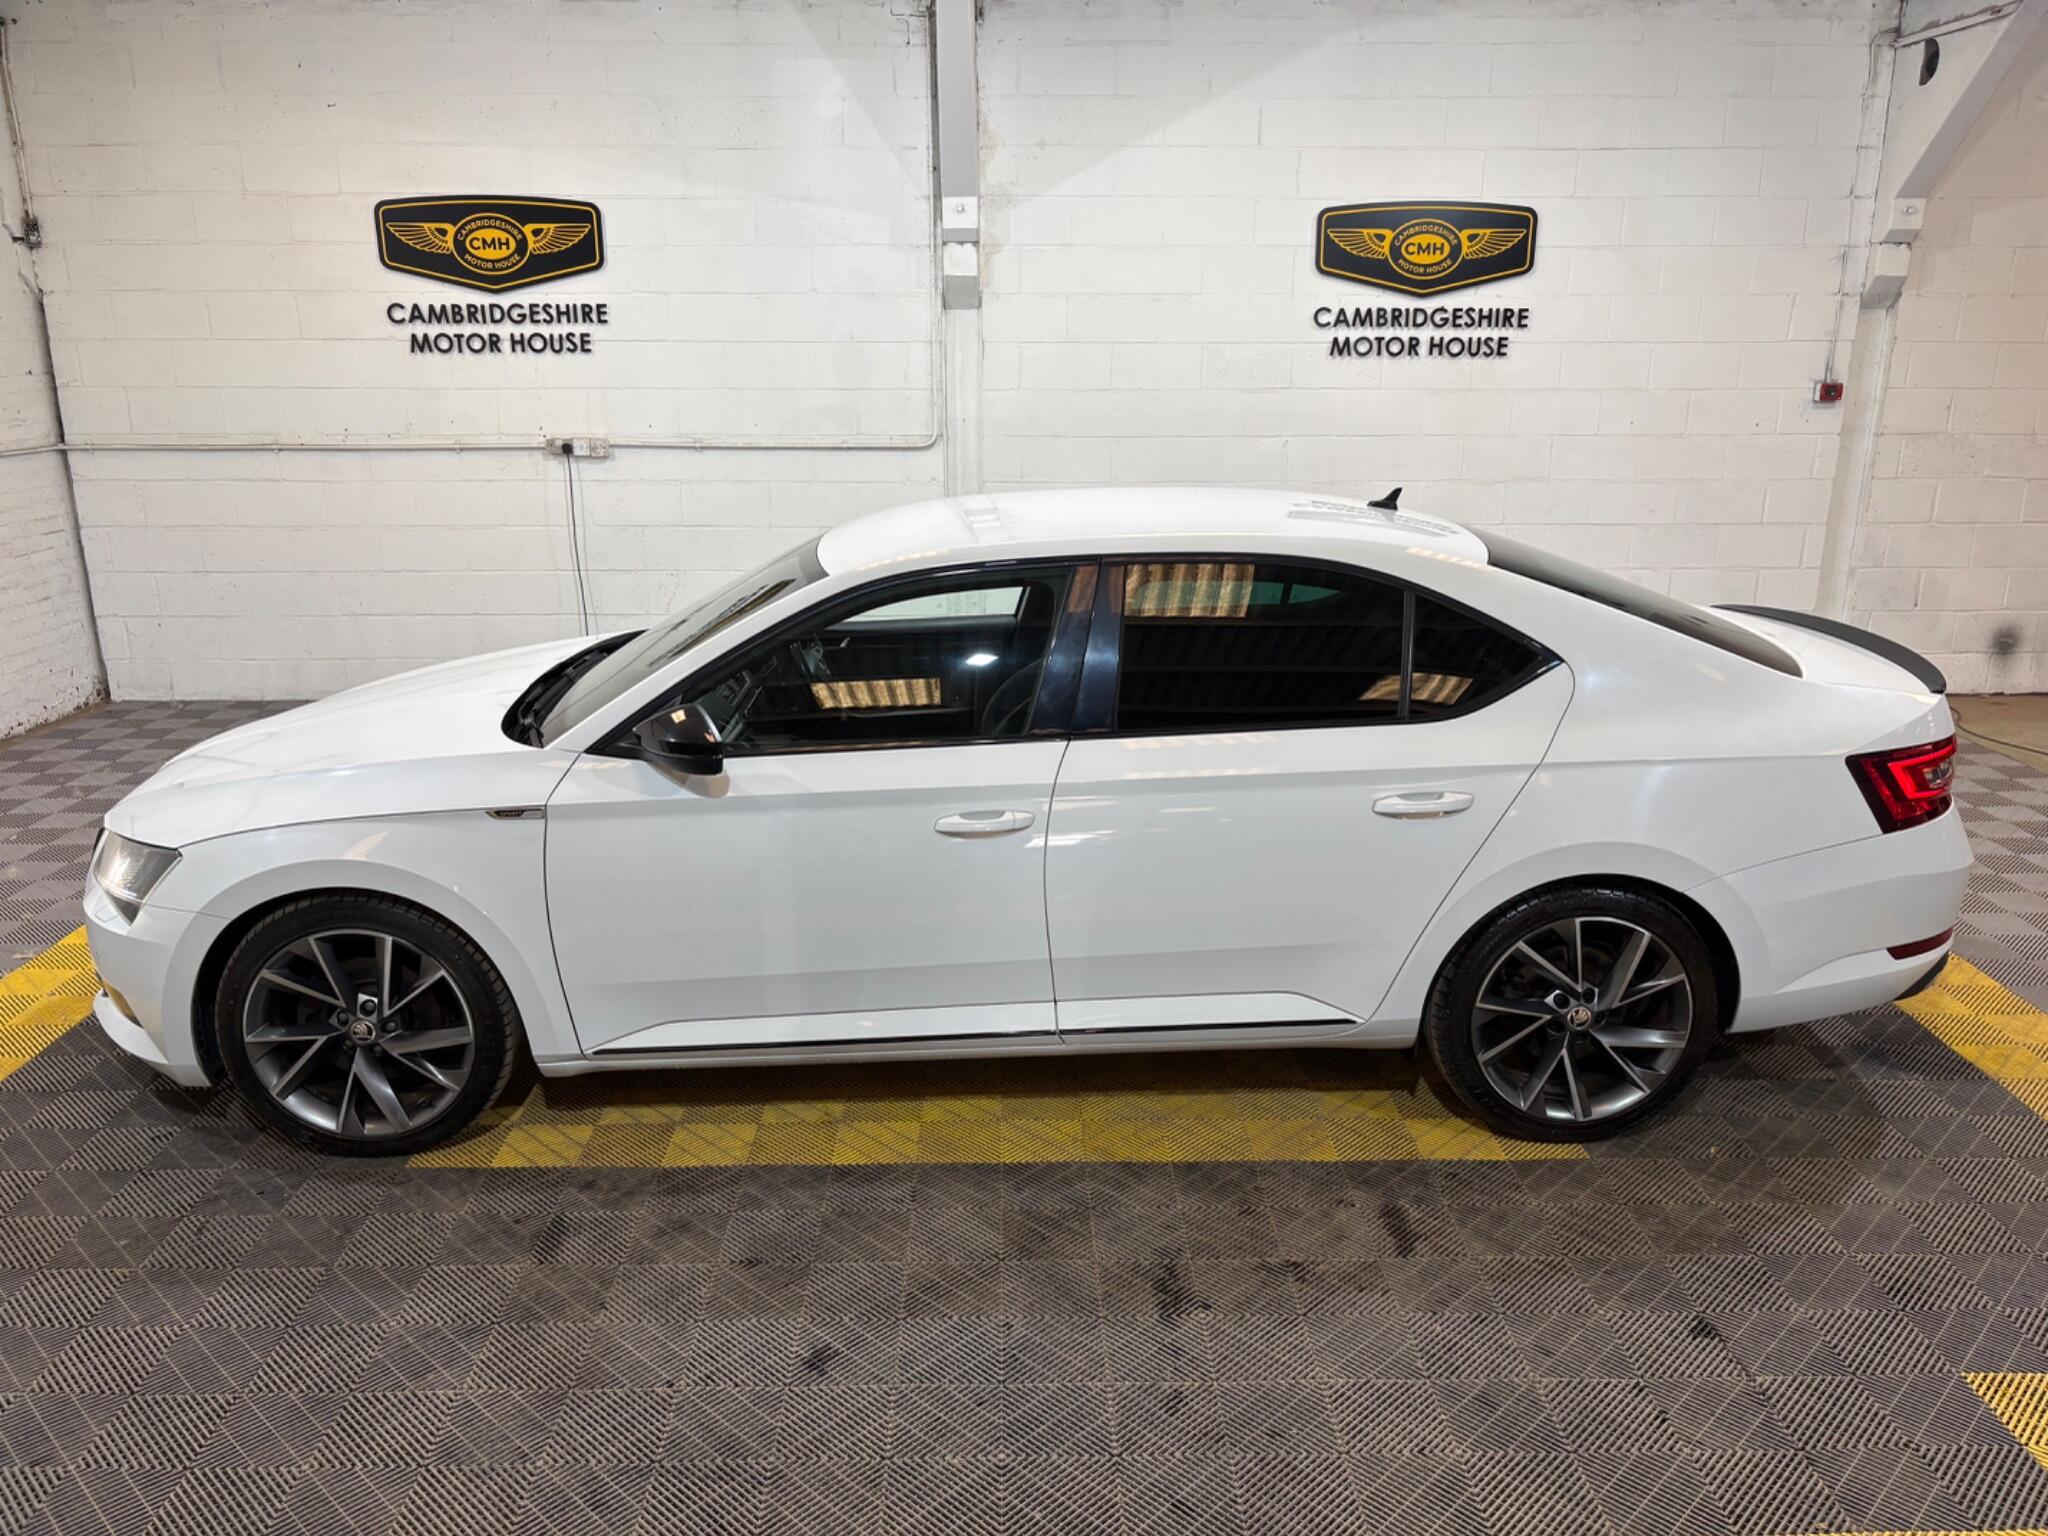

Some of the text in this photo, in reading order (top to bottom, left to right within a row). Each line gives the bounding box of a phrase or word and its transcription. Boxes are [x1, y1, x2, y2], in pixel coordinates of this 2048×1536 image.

[469, 236, 510, 250] CMH
[1405, 242, 1445, 256] CMH
[464, 253, 521, 269] MOTOR HOUSE
[1398, 258, 1424, 273] MOTOR
[386, 303, 608, 325] CAMBRIDGESHIRE
[1313, 307, 1530, 329] CAMBRIDGESHIRE
[410, 332, 593, 354] MOTOR HOUSE
[1329, 336, 1509, 357] MOTOR HOUSE
